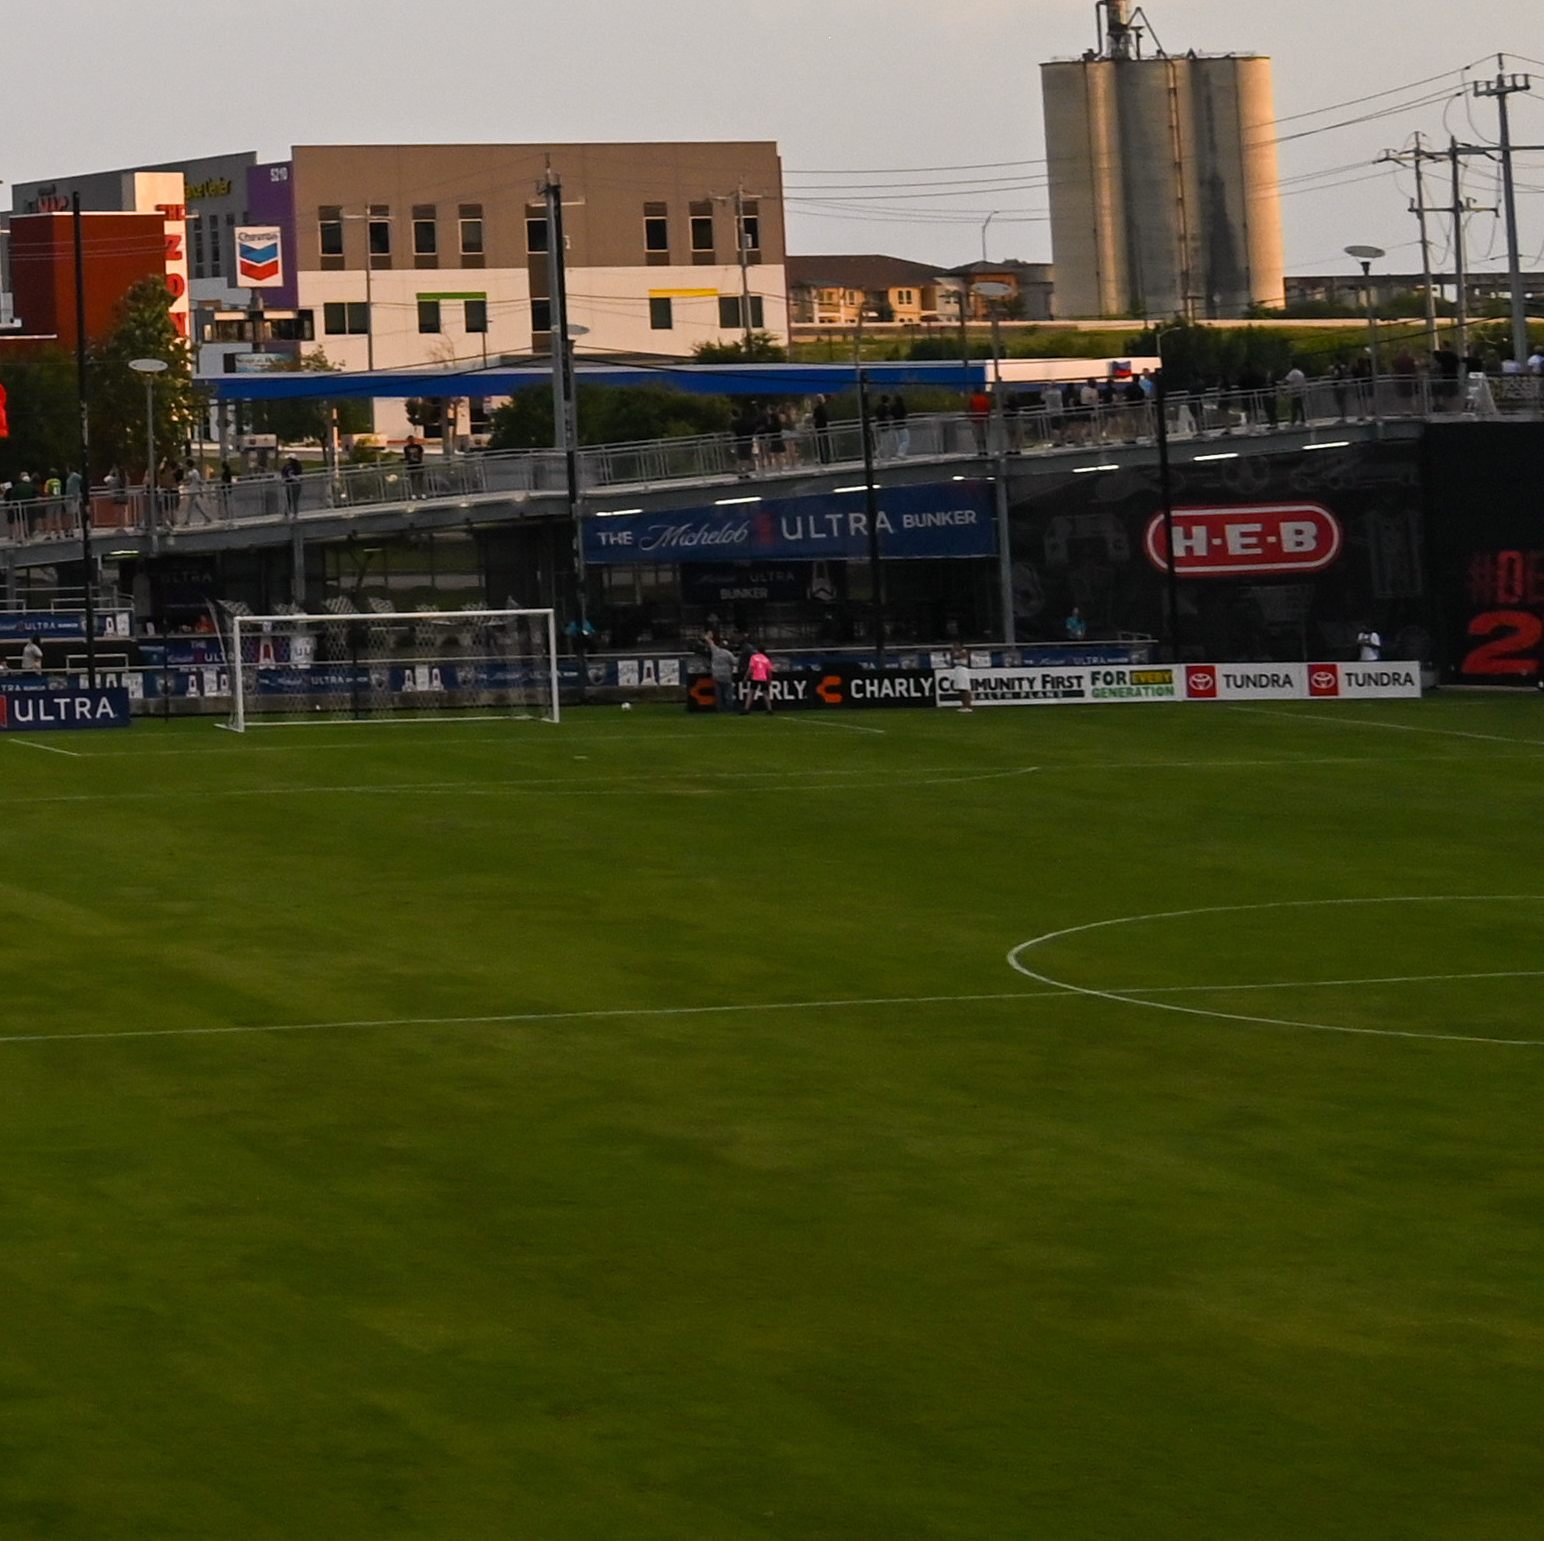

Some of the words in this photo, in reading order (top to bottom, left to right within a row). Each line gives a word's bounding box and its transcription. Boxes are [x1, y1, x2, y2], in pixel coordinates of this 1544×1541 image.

[597, 530, 633, 547] THE
[640, 520, 751, 551] Michelob
[781, 511, 893, 541] ULTRA
[903, 510, 977, 529] BUNKER
[720, 587, 768, 600] BUNKER
[938, 676, 1037, 692] CMUNITY
[1042, 674, 1084, 690] FIRST
[1091, 670, 1127, 686] FOR
[1131, 671, 1173, 684] EVERY
[1223, 673, 1294, 689] TUNDRA
[1345, 671, 1415, 687] TUNDRA
[732, 680, 808, 700] HARLY
[850, 677, 931, 698] CHARLY
[1092, 686, 1175, 699] GENERATION
[14, 697, 115, 722] ULTRA
